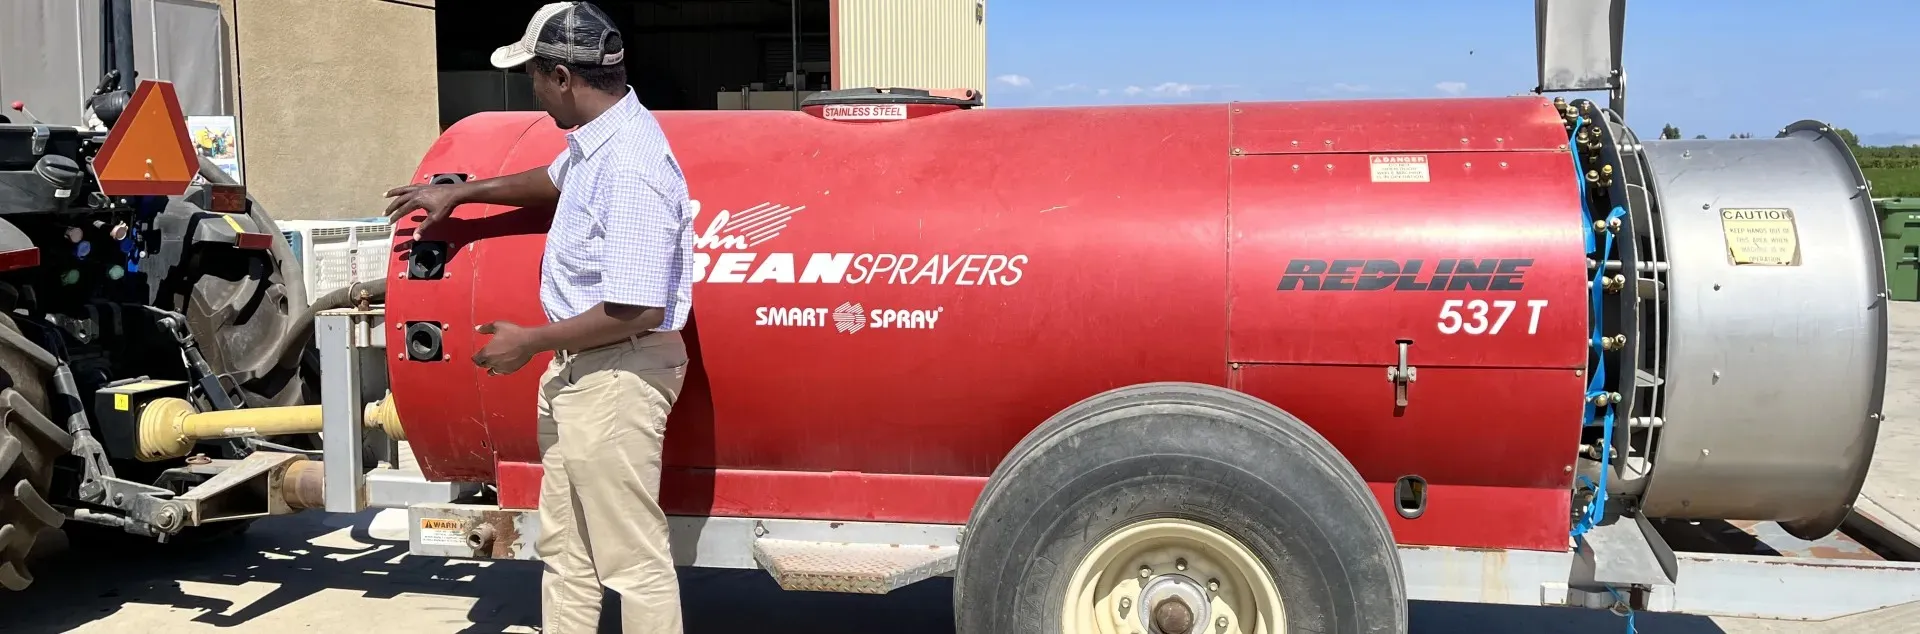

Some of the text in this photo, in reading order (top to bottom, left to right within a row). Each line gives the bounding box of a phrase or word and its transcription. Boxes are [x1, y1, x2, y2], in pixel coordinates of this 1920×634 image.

[825, 107, 903, 117] STAINLESS STEEL
[846, 253, 1028, 286] SPRAYERS
[1277, 259, 1534, 291] REDLINE
[755, 306, 938, 329] SMART SPRAY
[1437, 299, 1549, 335] 537 T
